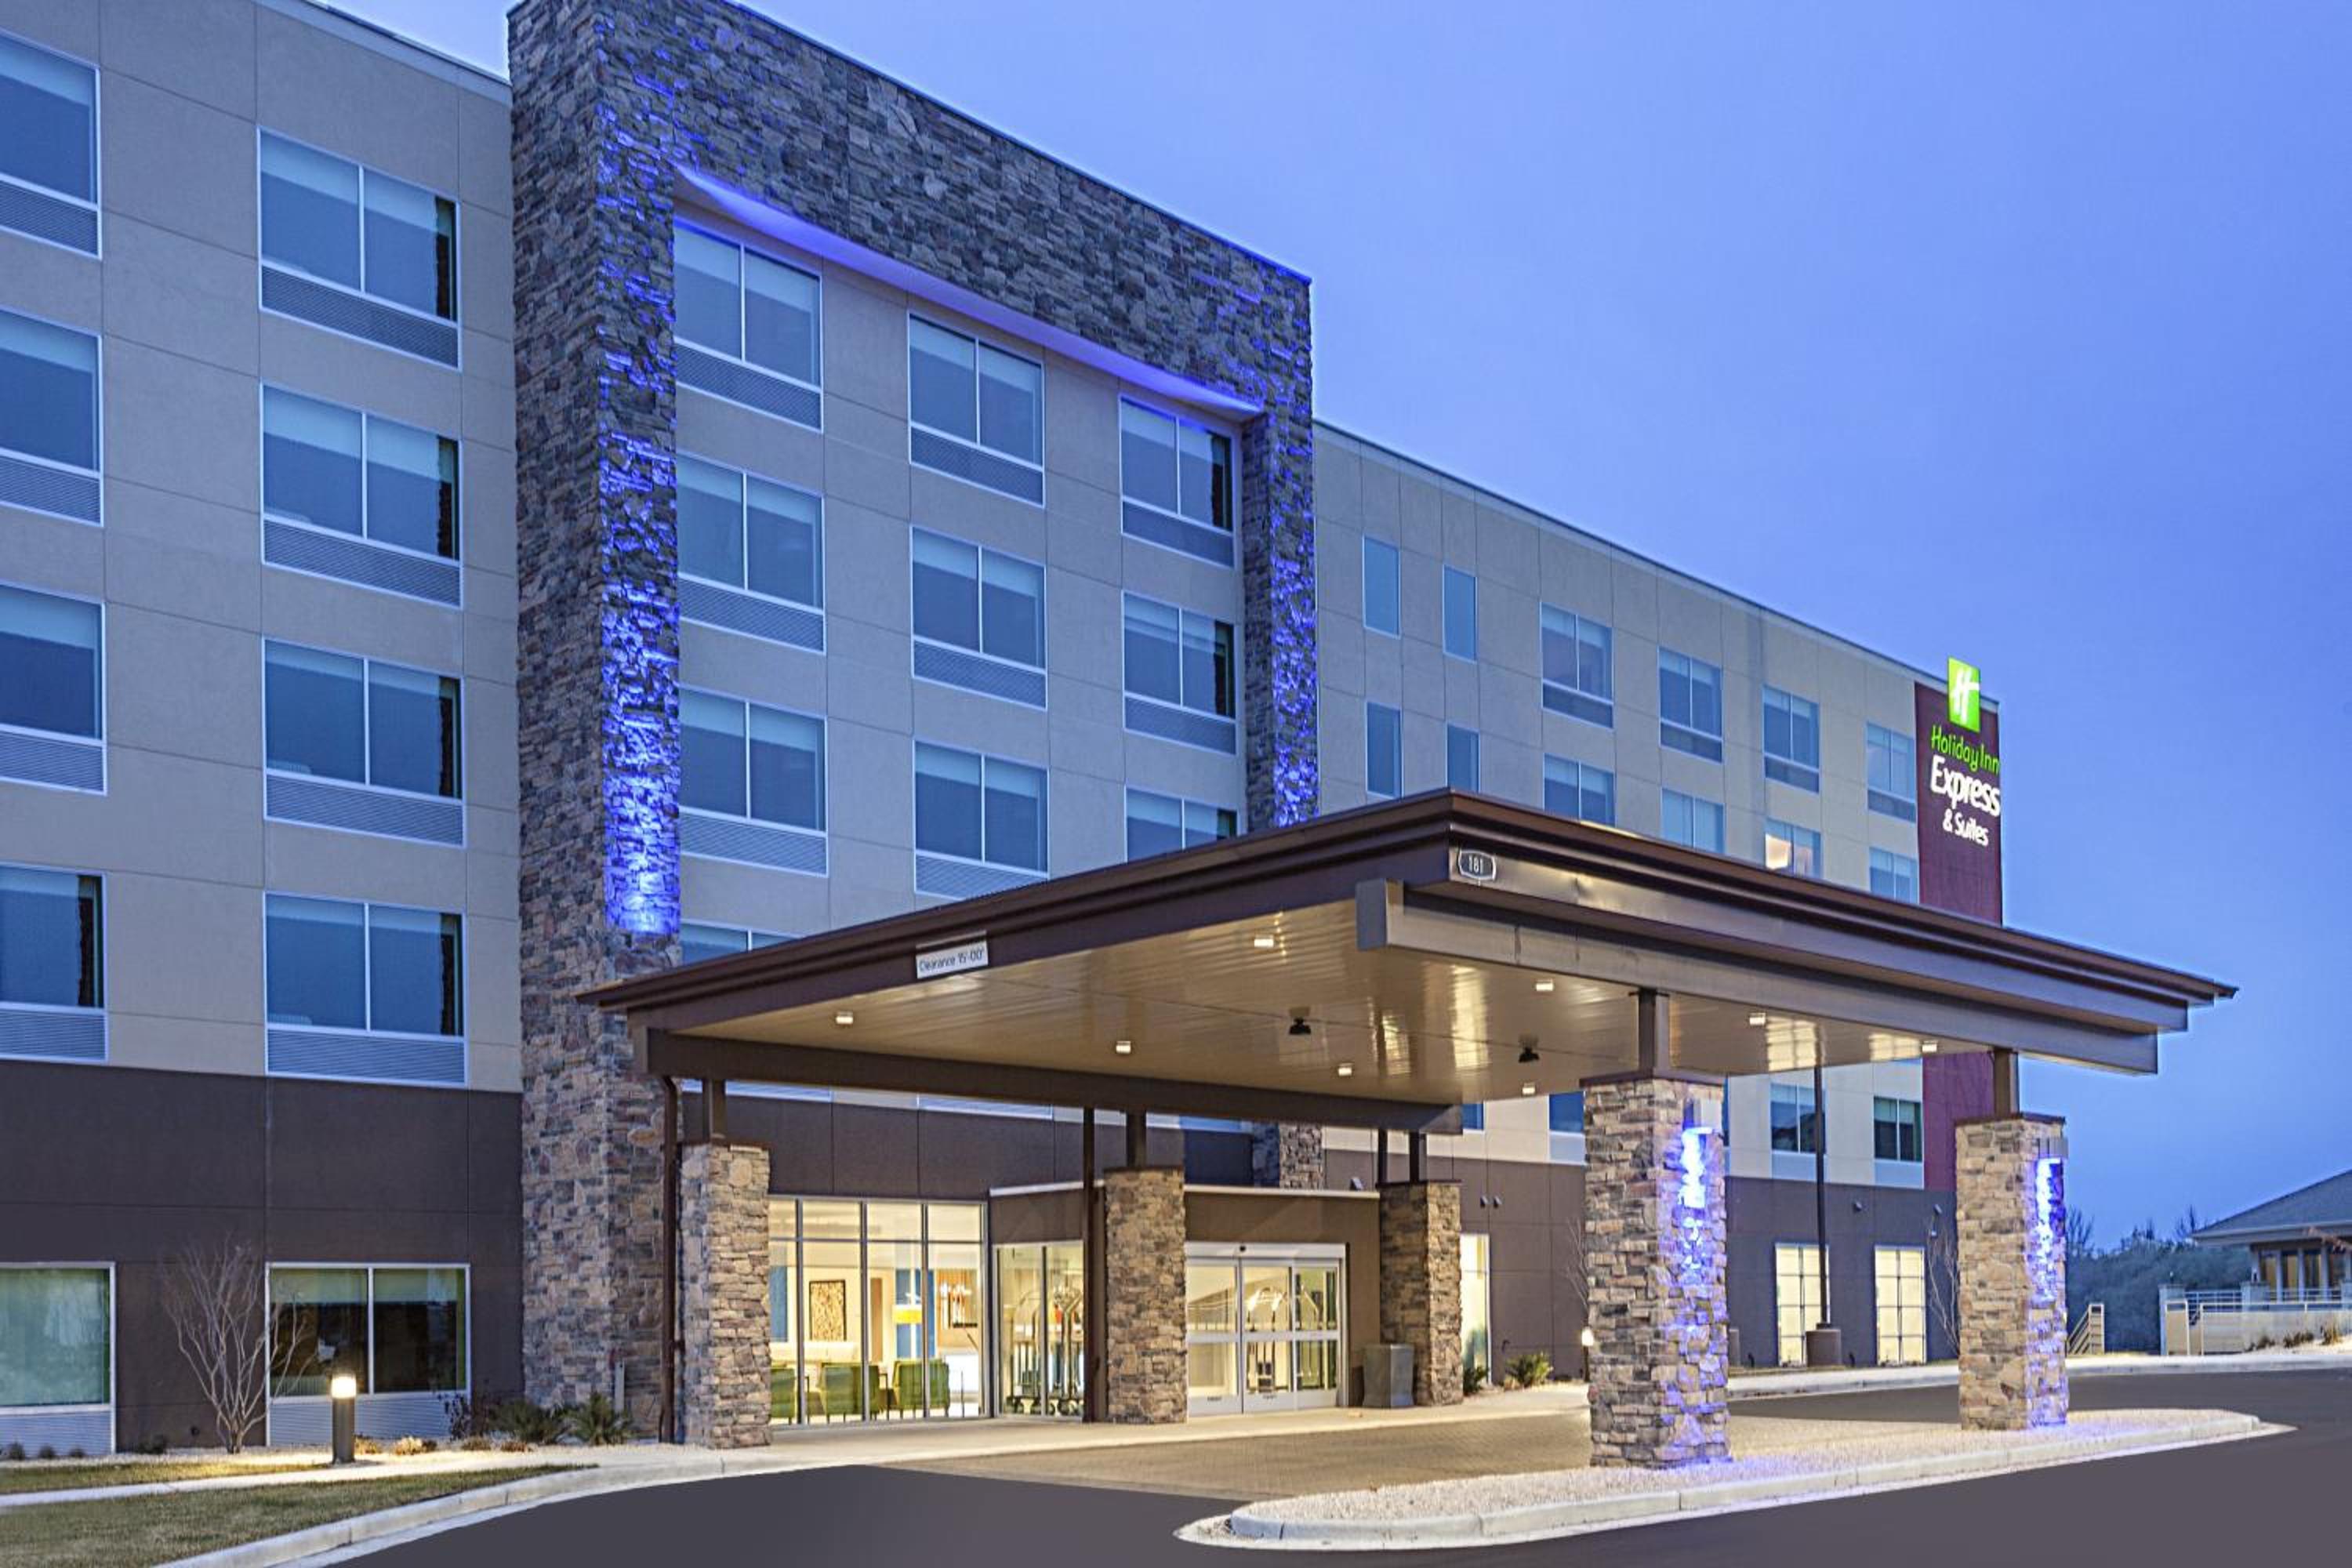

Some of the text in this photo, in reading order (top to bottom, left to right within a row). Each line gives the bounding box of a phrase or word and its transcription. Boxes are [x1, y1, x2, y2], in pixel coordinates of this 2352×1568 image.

[1931, 724, 2000, 776] Holiday Inn
[1930, 754, 2001, 817] Express
[1943, 808, 1989, 847] & Suites
[1468, 855, 1483, 874] 181
[919, 956, 956, 972] Clearance
